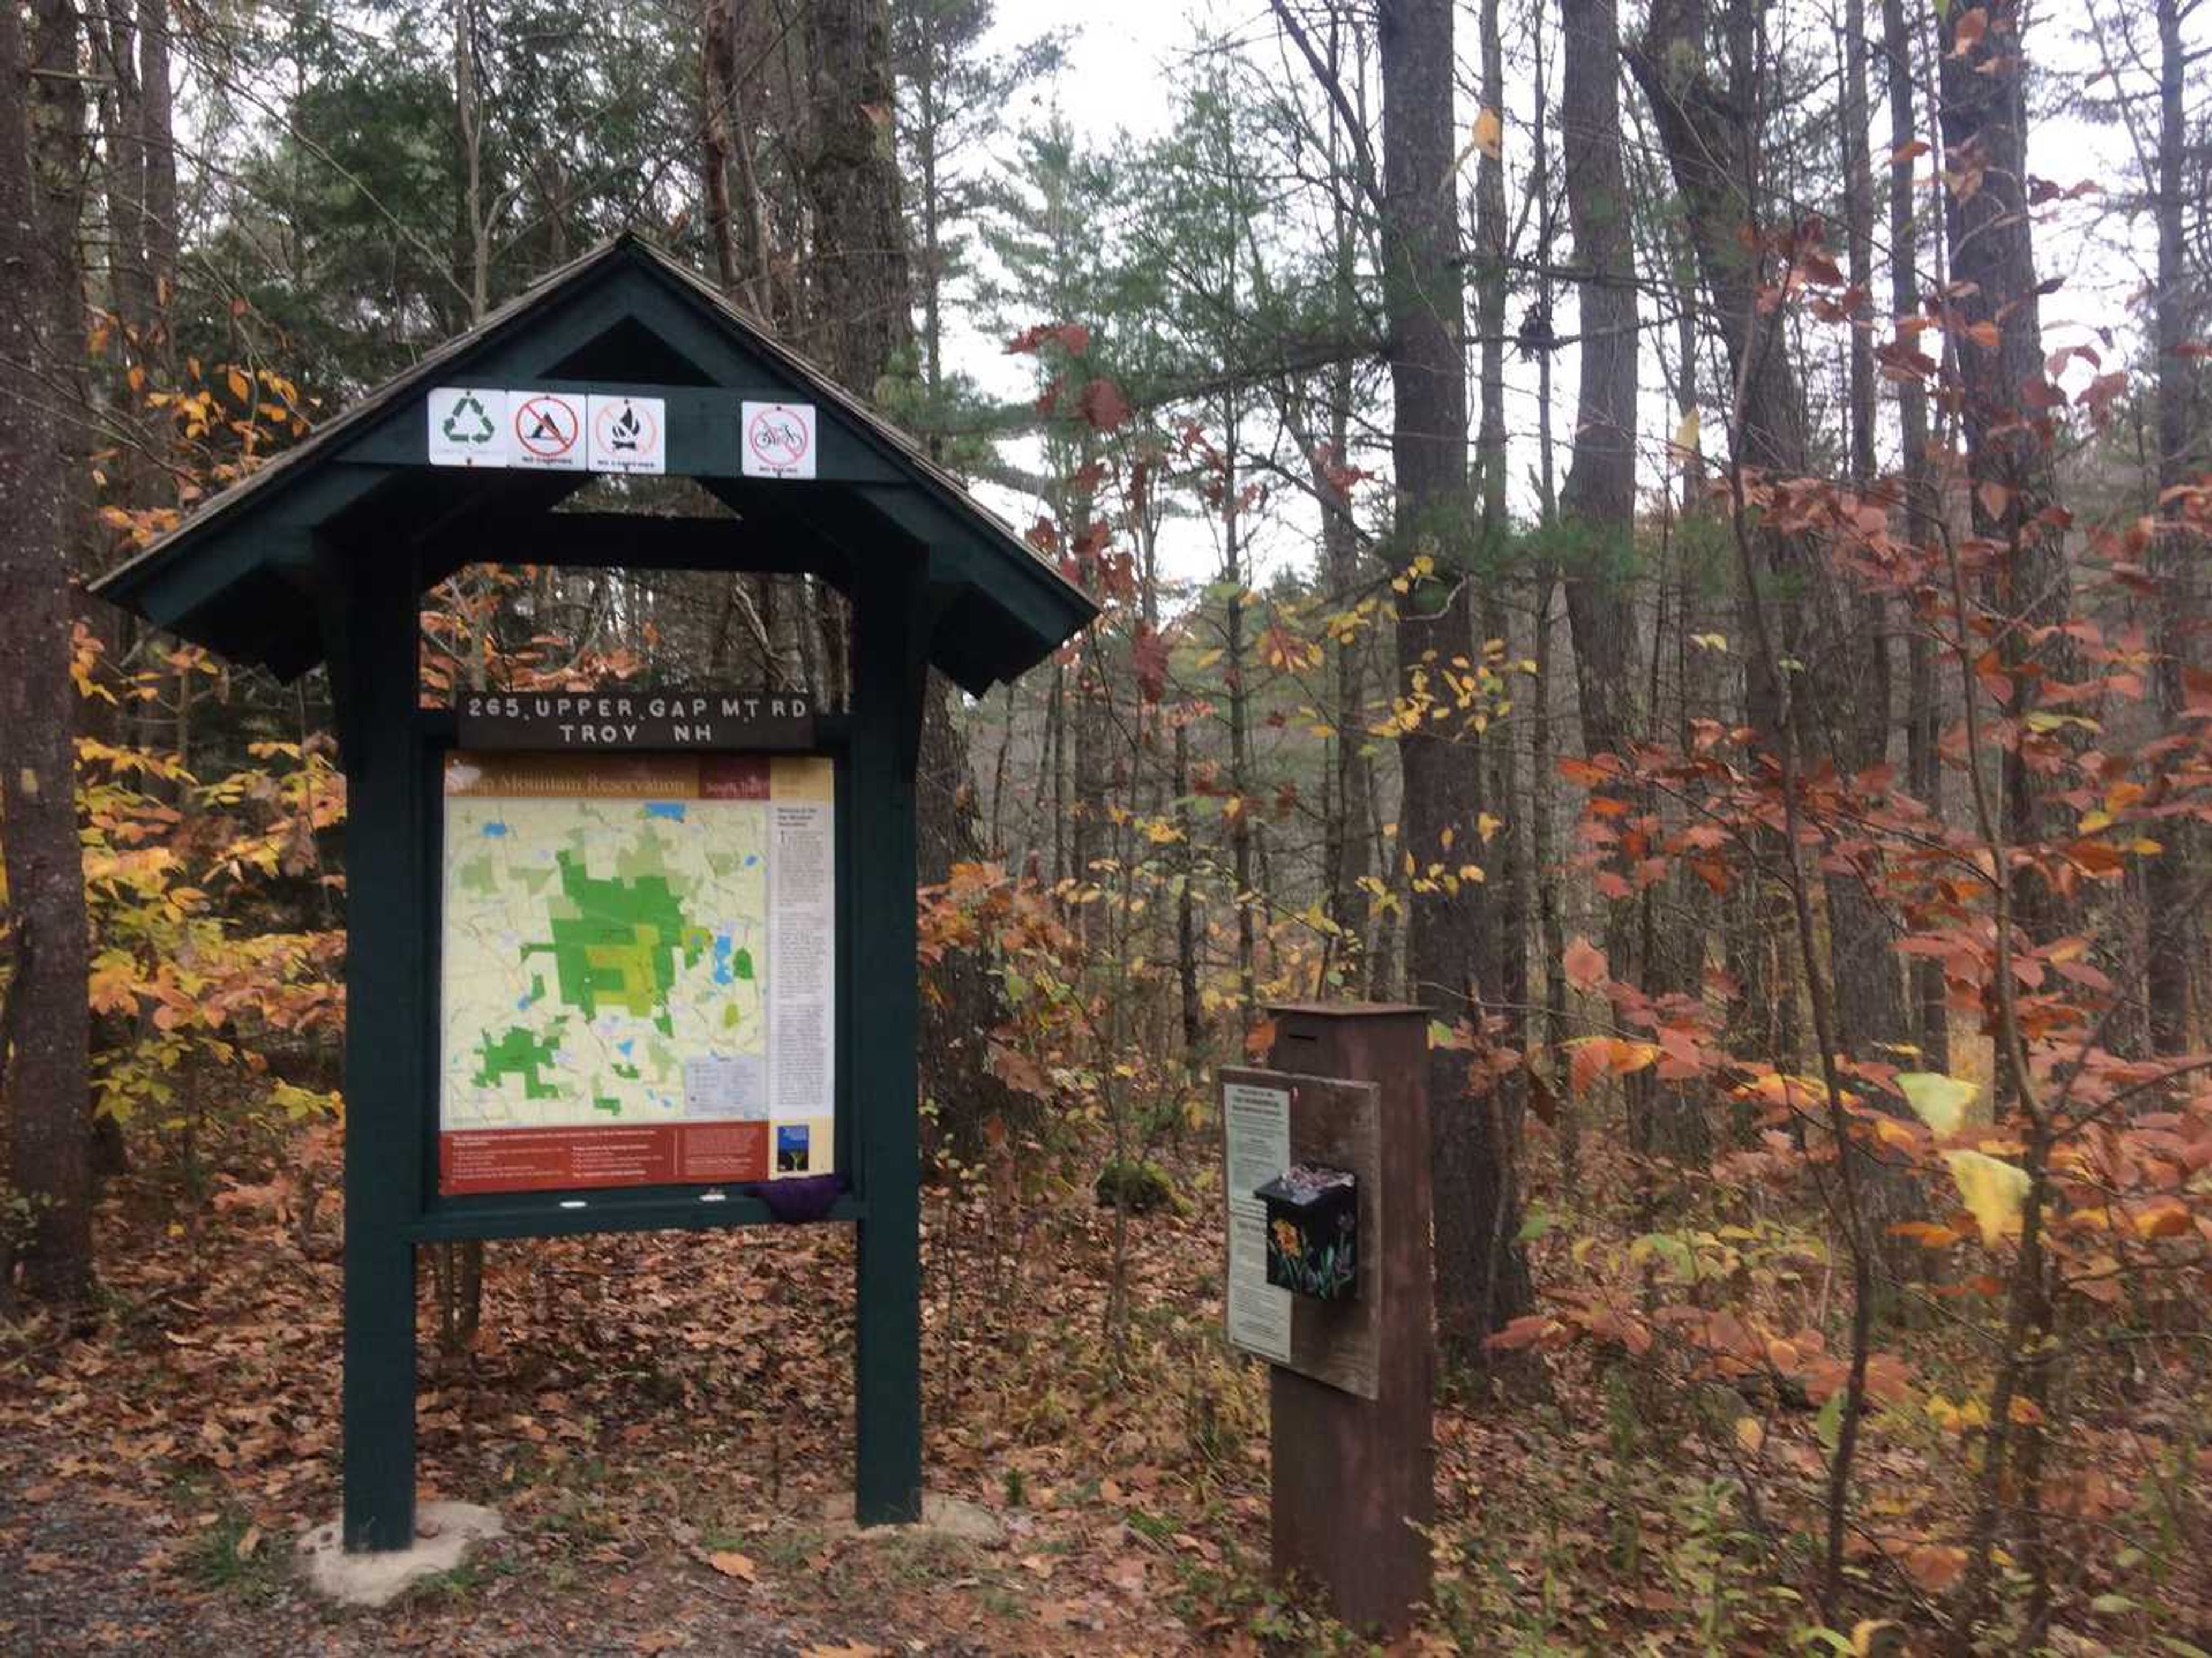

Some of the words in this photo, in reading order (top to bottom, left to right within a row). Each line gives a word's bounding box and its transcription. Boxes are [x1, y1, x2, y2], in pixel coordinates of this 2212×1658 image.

[771, 698, 806, 718] RD
[558, 724, 637, 743] TROY
[673, 723, 712, 742] NH
